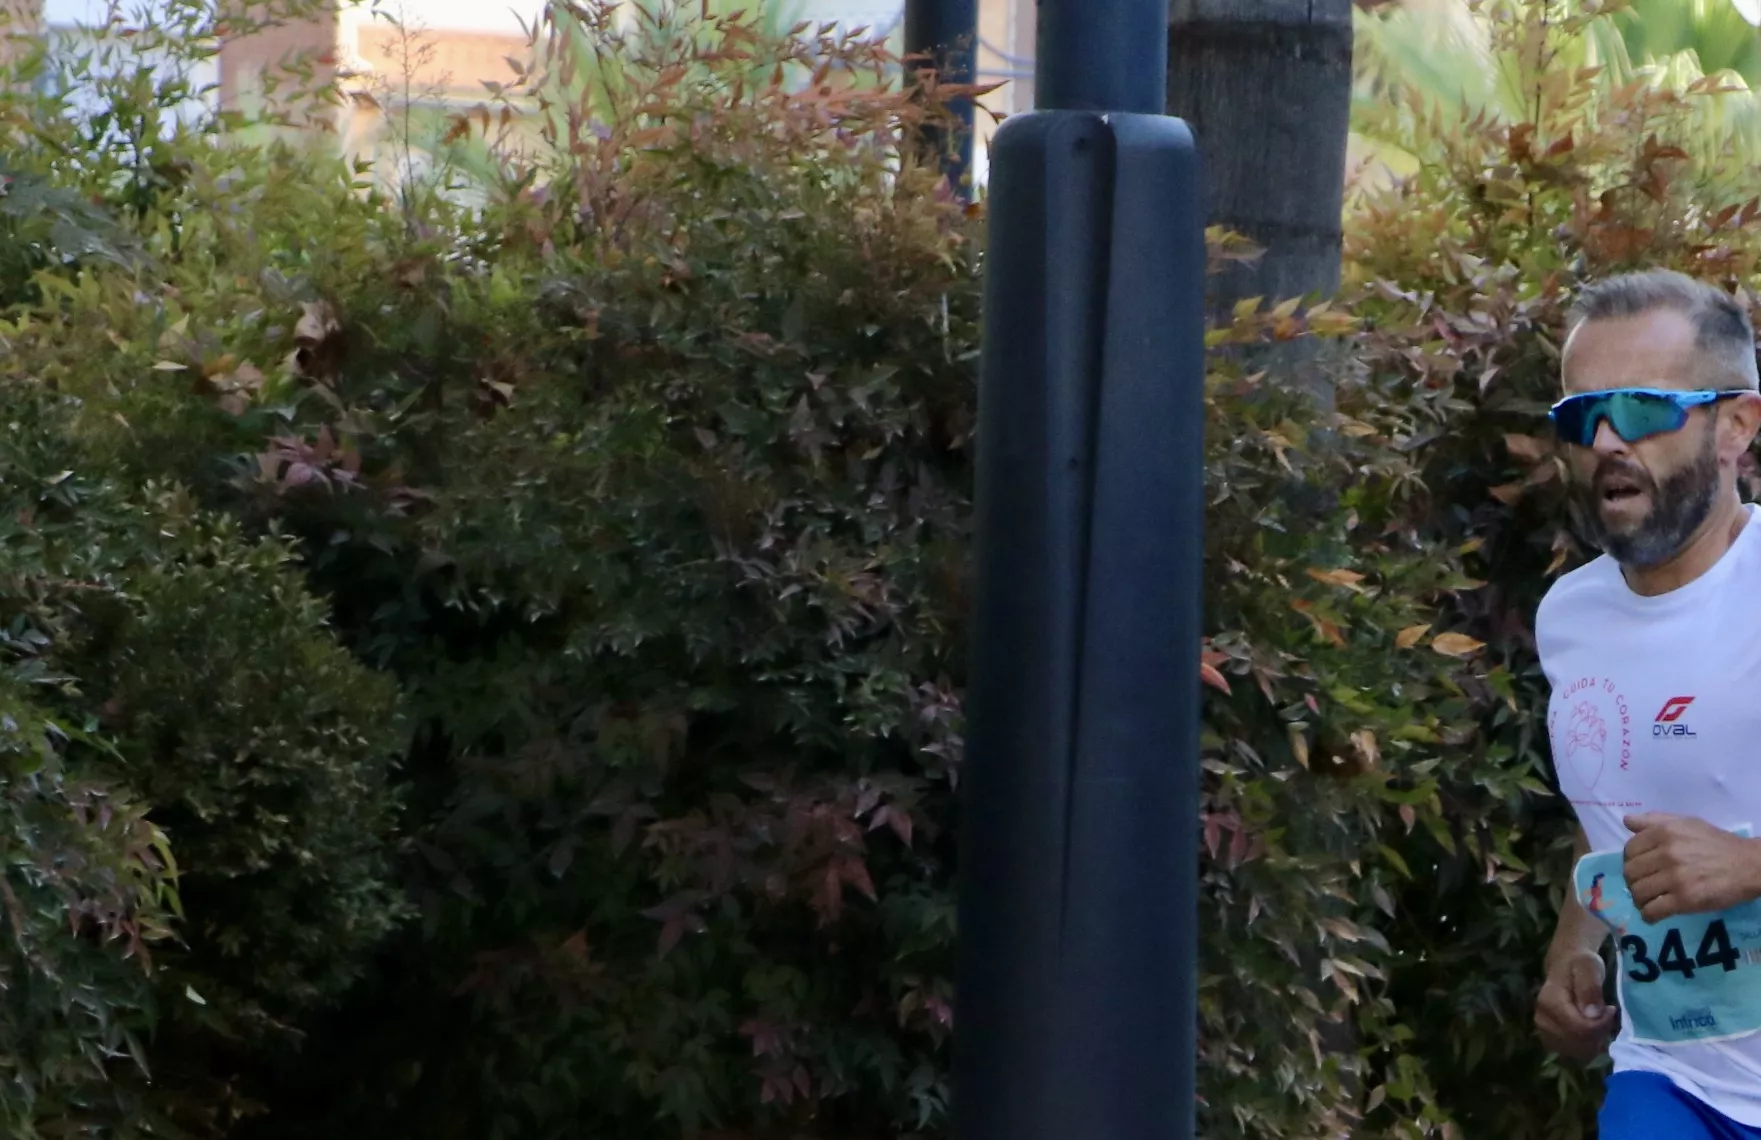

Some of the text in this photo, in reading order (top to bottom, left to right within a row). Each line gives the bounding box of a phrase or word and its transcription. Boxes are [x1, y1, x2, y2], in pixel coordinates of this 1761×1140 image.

[1563, 677, 1597, 699] CUIDA
[1602, 678, 1616, 693] TU
[1620, 918, 1741, 983] 344
